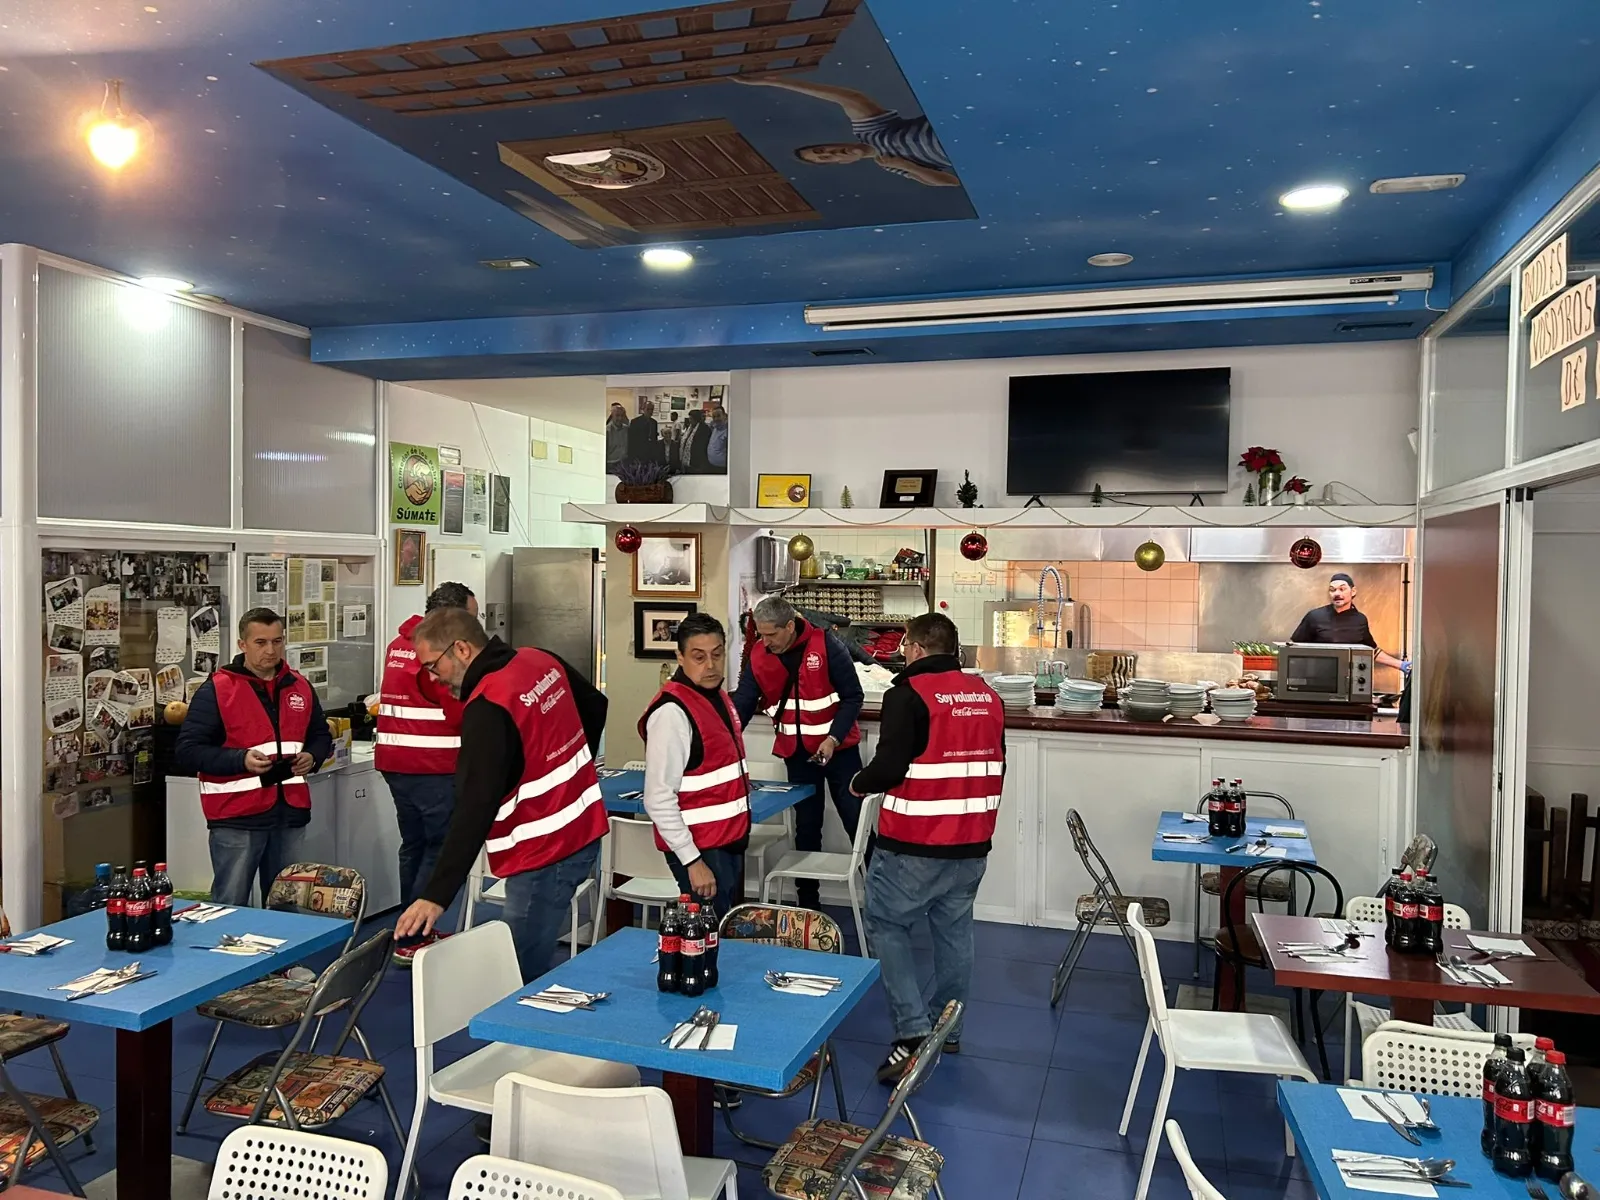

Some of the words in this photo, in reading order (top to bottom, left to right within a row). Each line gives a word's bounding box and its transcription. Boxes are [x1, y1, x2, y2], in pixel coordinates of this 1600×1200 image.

[1533, 284, 1592, 361] VOSOTROS
[1564, 355, 1582, 405] DE
[397, 507, 436, 521] SÚMATE
[519, 689, 539, 706] Soy
[935, 692, 953, 705] Soy
